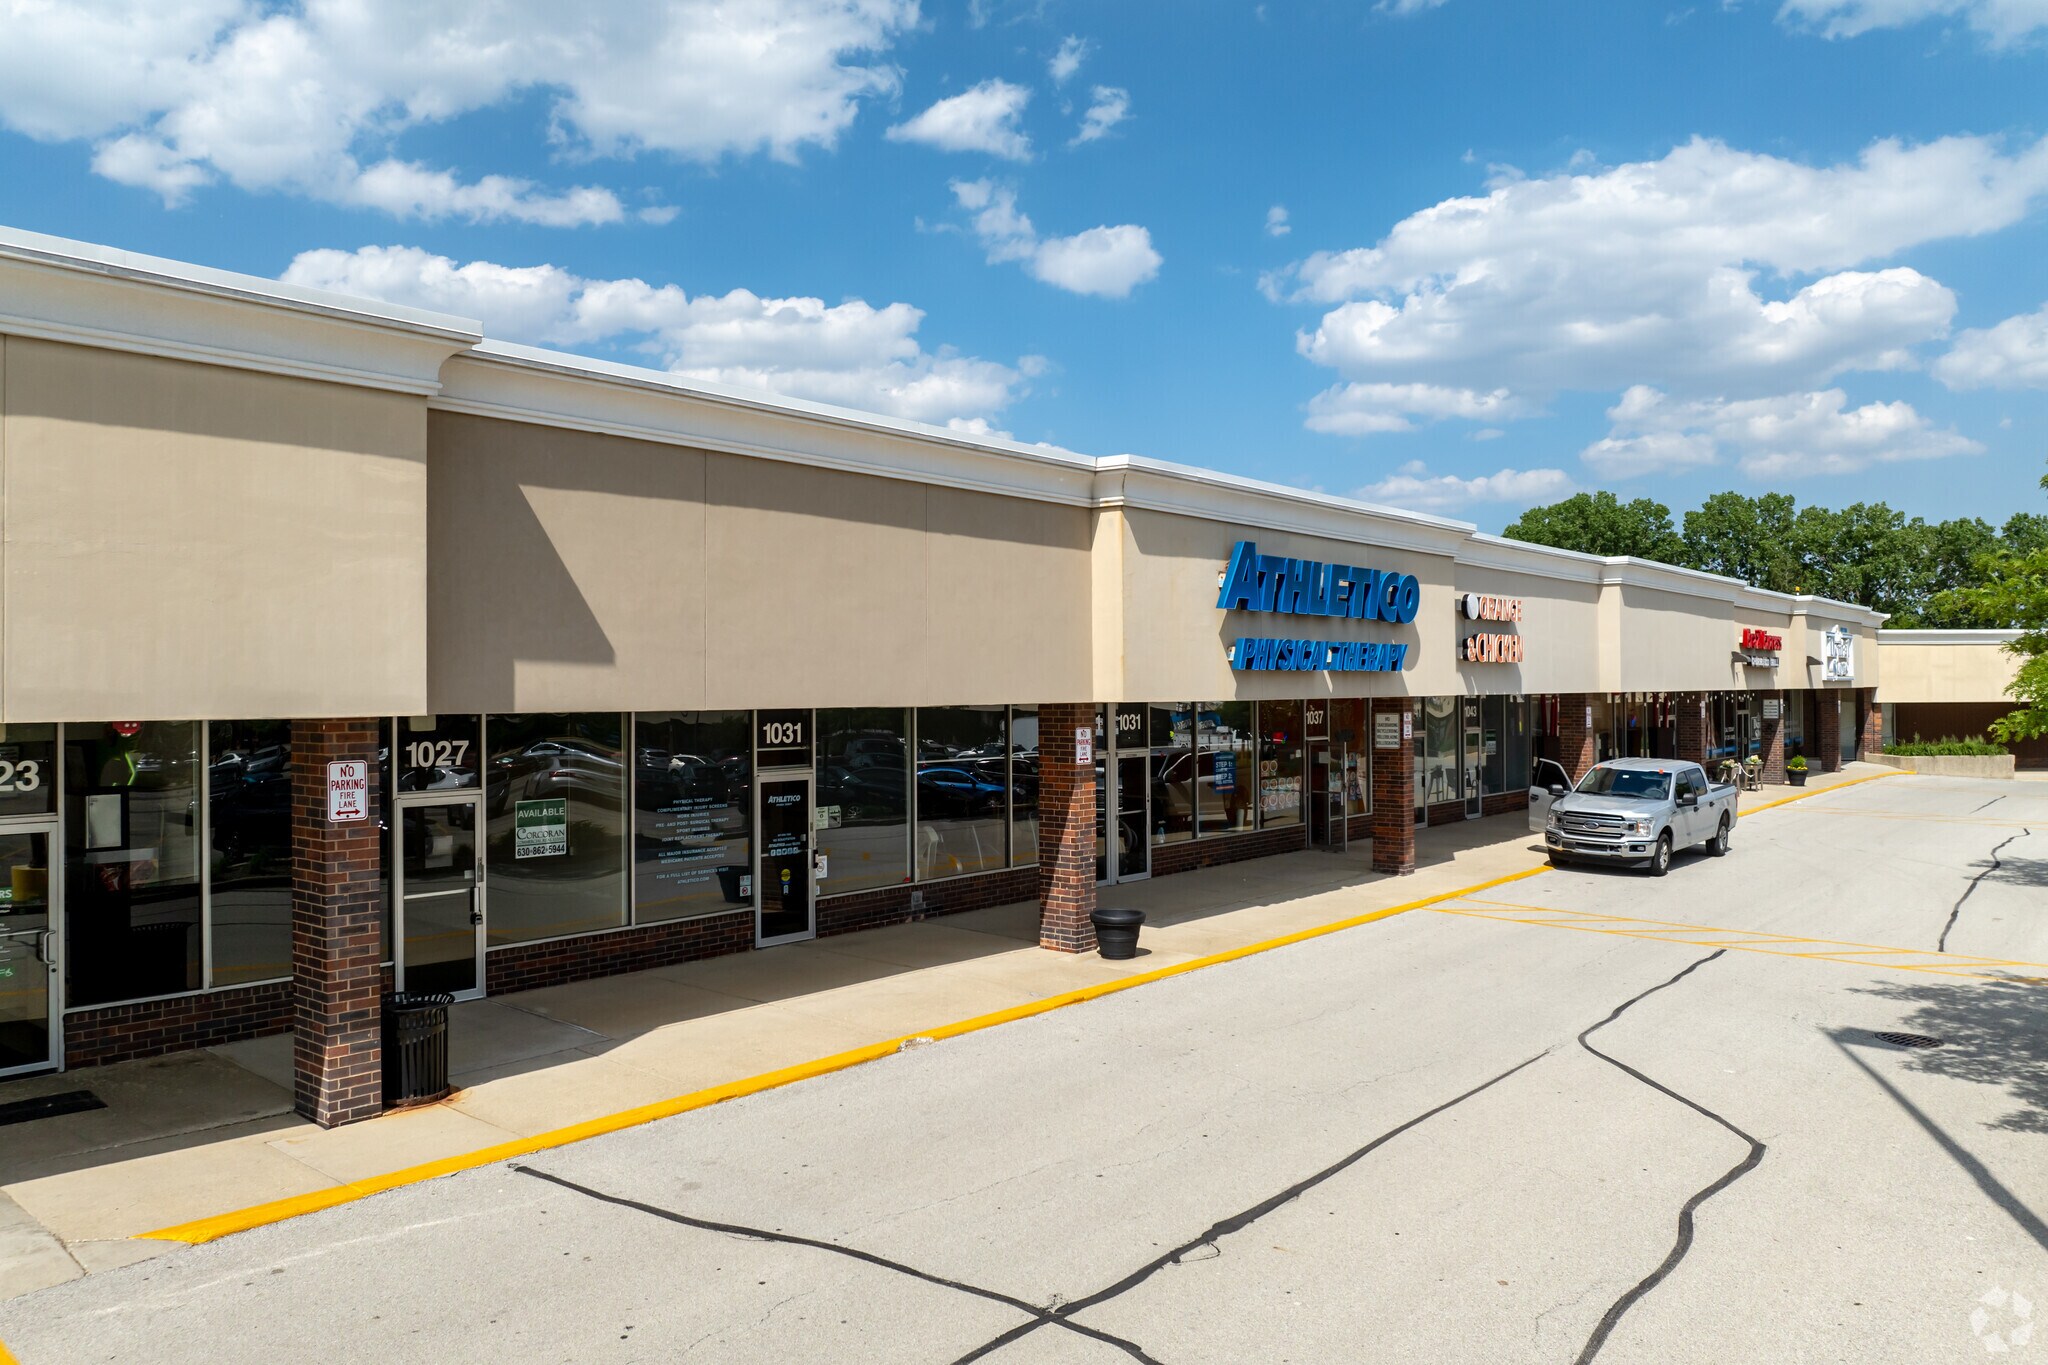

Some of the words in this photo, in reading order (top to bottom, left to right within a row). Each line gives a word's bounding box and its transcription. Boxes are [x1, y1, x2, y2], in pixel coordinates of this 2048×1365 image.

[1216, 541, 1420, 624] ATHLETICO
[1479, 596, 1522, 622] ORANGE
[1232, 637, 1331, 671] PHYSICAL
[1330, 641, 1408, 672] THERAPY
[1476, 633, 1525, 663] CHICKEN
[1306, 710, 1324, 725] 1037
[1464, 705, 1477, 718] 1043
[1118, 713, 1141, 731] 1031
[763, 722, 802, 744] 1031
[405, 740, 470, 768] 1027
[340, 766, 354, 777] NO
[331, 778, 365, 791] PARKING
[339, 791, 356, 800] FIRE
[767, 794, 801, 804] ATHLETICO
[338, 800, 357, 809] LANE
[518, 807, 565, 818] AVAILABLE
[516, 828, 565, 840] CORCORAN
